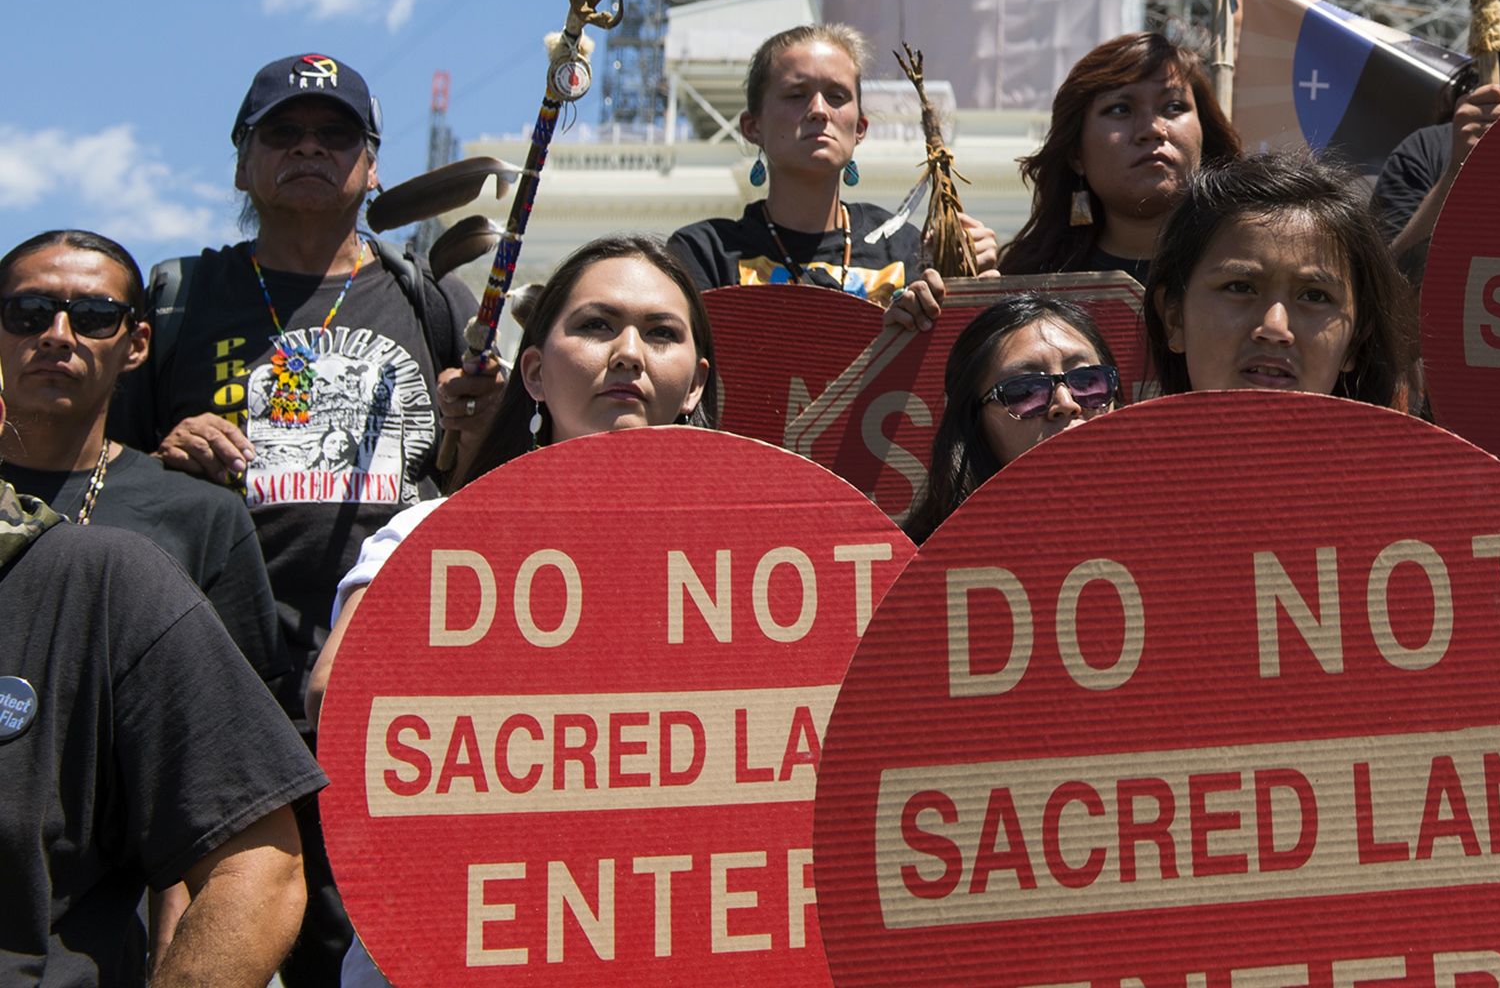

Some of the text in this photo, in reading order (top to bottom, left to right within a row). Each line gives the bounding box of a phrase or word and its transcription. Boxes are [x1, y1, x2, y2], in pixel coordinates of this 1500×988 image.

[253, 470, 399, 505] SACRED SITES
[429, 542, 893, 648] DO NOT
[945, 558, 1146, 698] DO
[384, 706, 823, 797] SACRED LA
[900, 766, 1319, 900] SACRED
